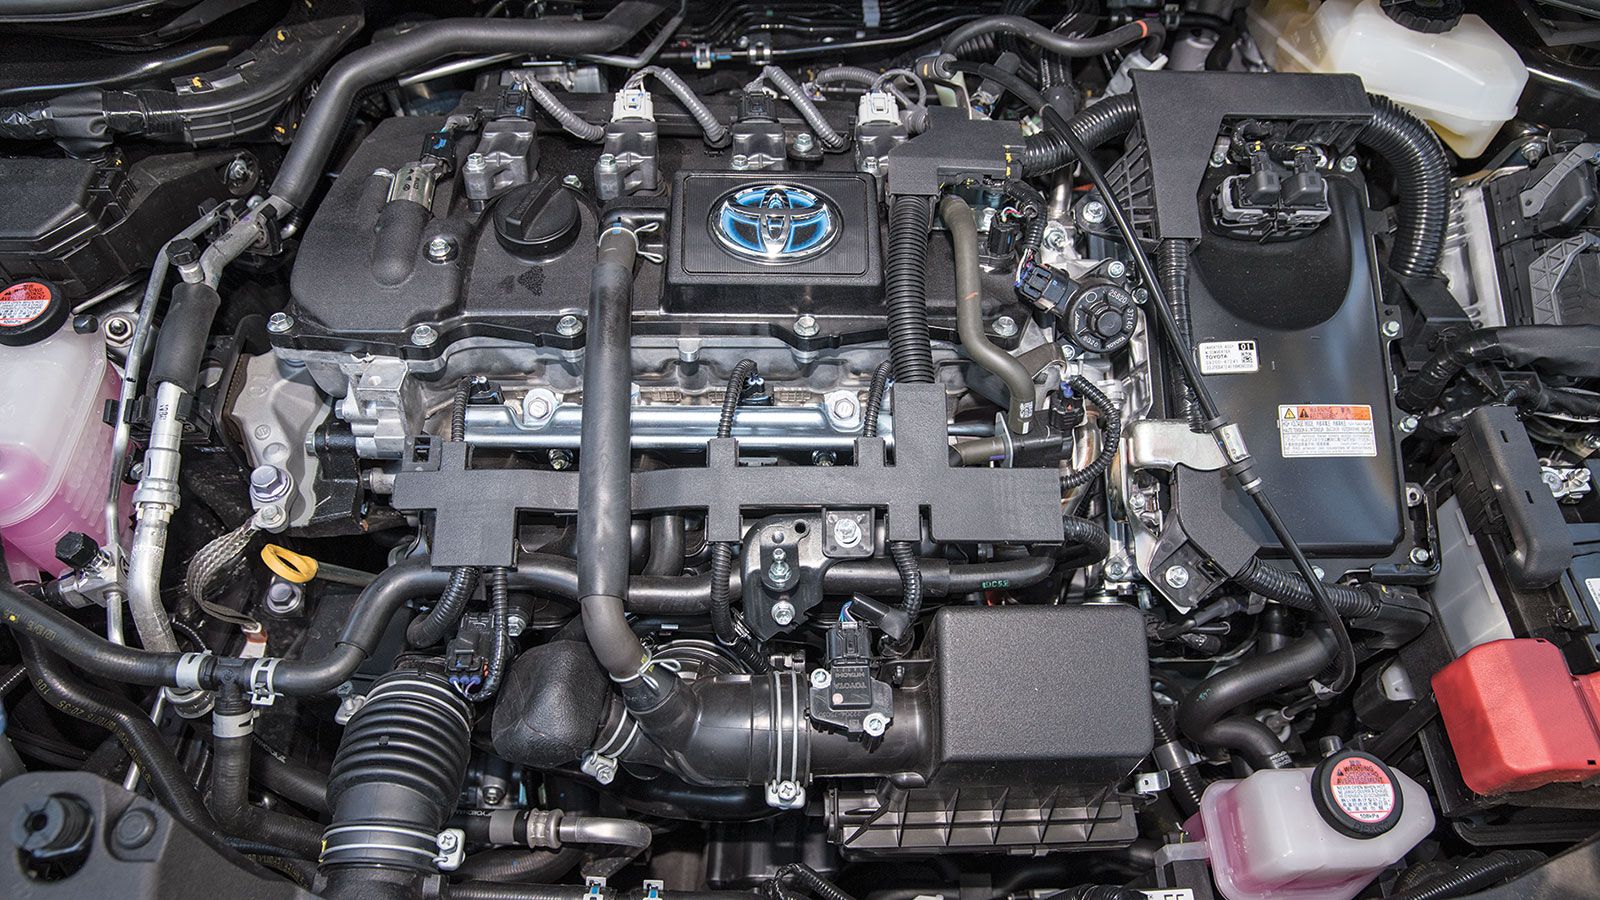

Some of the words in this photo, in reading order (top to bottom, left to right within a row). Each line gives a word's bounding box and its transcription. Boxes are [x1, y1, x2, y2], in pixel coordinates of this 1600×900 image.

[1108, 289, 1128, 303] 25620
[1126, 308, 1134, 330] 37140
[1106, 336, 1126, 349] TOYOTA
